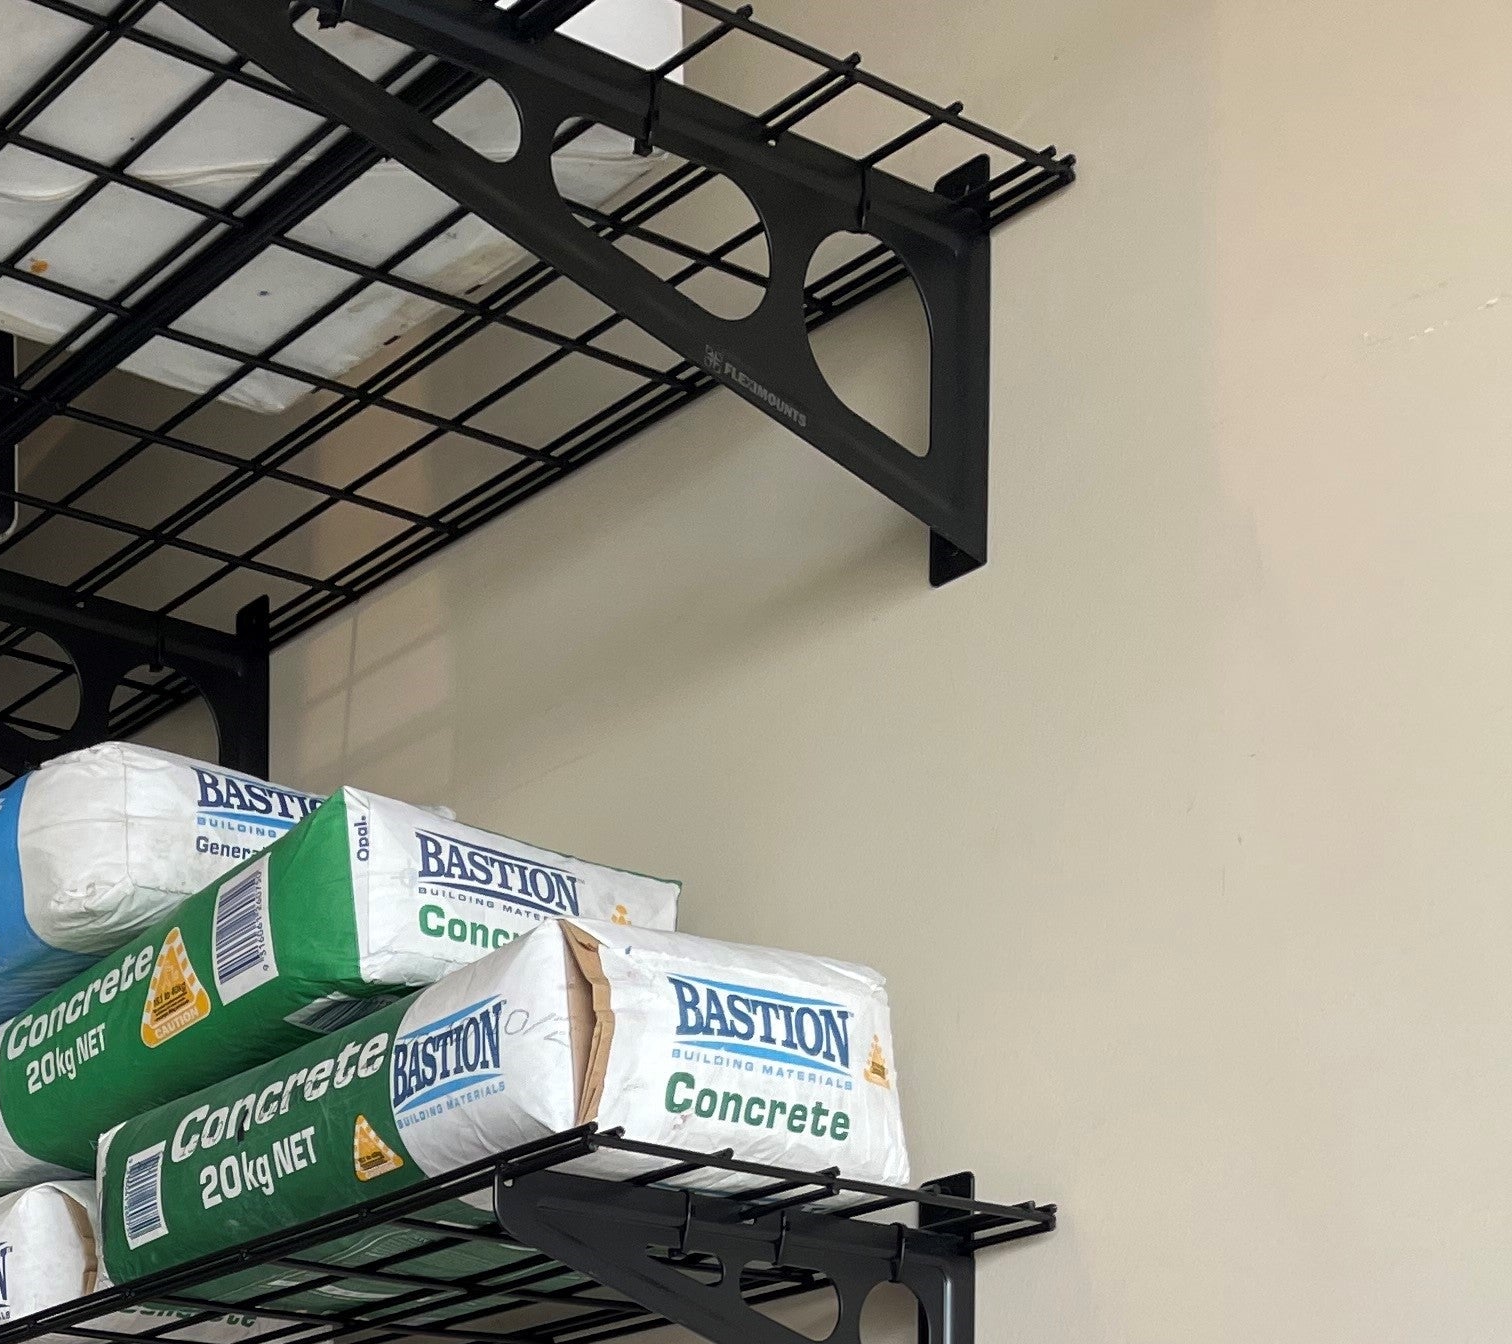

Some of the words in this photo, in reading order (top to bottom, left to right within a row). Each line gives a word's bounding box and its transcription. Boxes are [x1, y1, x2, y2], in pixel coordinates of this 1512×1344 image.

[196, 836, 258, 860] Gener
[197, 816, 278, 838] BUILDING
[415, 831, 580, 917] BASTION
[418, 887, 495, 908] BUILDING
[7, 946, 154, 1061] Concrete
[154, 1006, 199, 1039] CAUTION
[667, 976, 850, 1069] BASTION
[26, 1046, 77, 1094] 20kg
[76, 1023, 106, 1064] NET
[394, 1001, 503, 1109] BASTION
[671, 1048, 755, 1072] BUILDING
[762, 1064, 854, 1091] MATERIALS
[171, 1032, 389, 1163] Concrete
[397, 1104, 444, 1130] BUILDING
[446, 1080, 506, 1111] MATERIALS
[664, 1071, 851, 1142] Concrete
[199, 1151, 275, 1209] 20kg
[272, 1126, 317, 1178] NET
